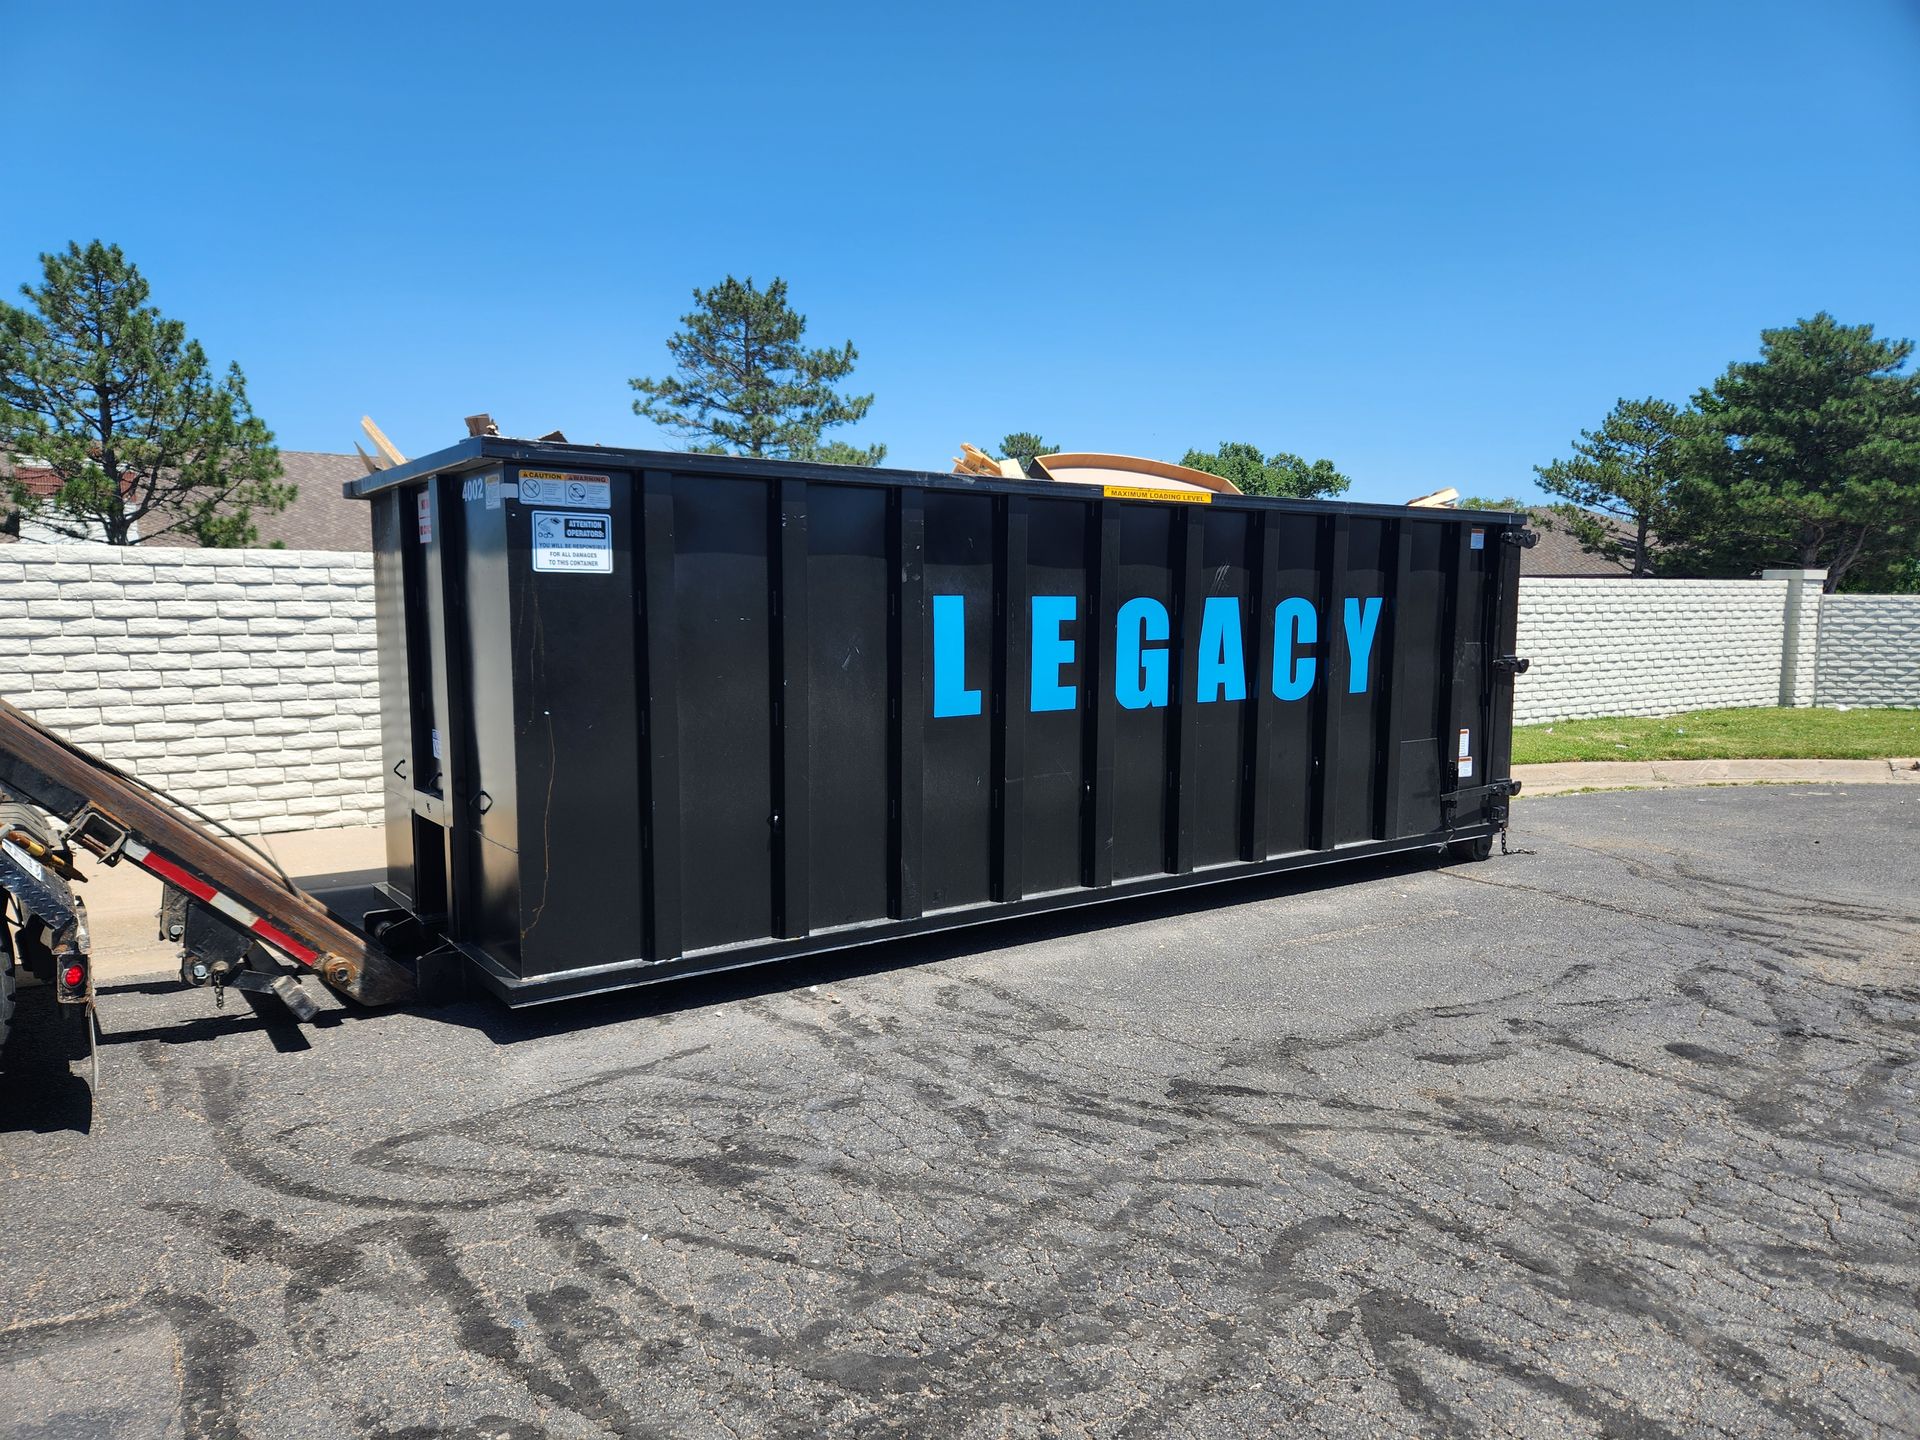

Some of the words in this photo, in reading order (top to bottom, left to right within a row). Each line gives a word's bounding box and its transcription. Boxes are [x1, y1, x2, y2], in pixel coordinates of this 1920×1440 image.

[573, 475, 606, 483] WARNING
[462, 478, 484, 502] 4002
[1111, 490, 1148, 498] MAXIMUM
[1150, 492, 1181, 500] LOADING
[1183, 494, 1204, 502] LEVEL
[568, 520, 602, 529] ATTENTION
[932, 595, 1383, 719] LEGACY
